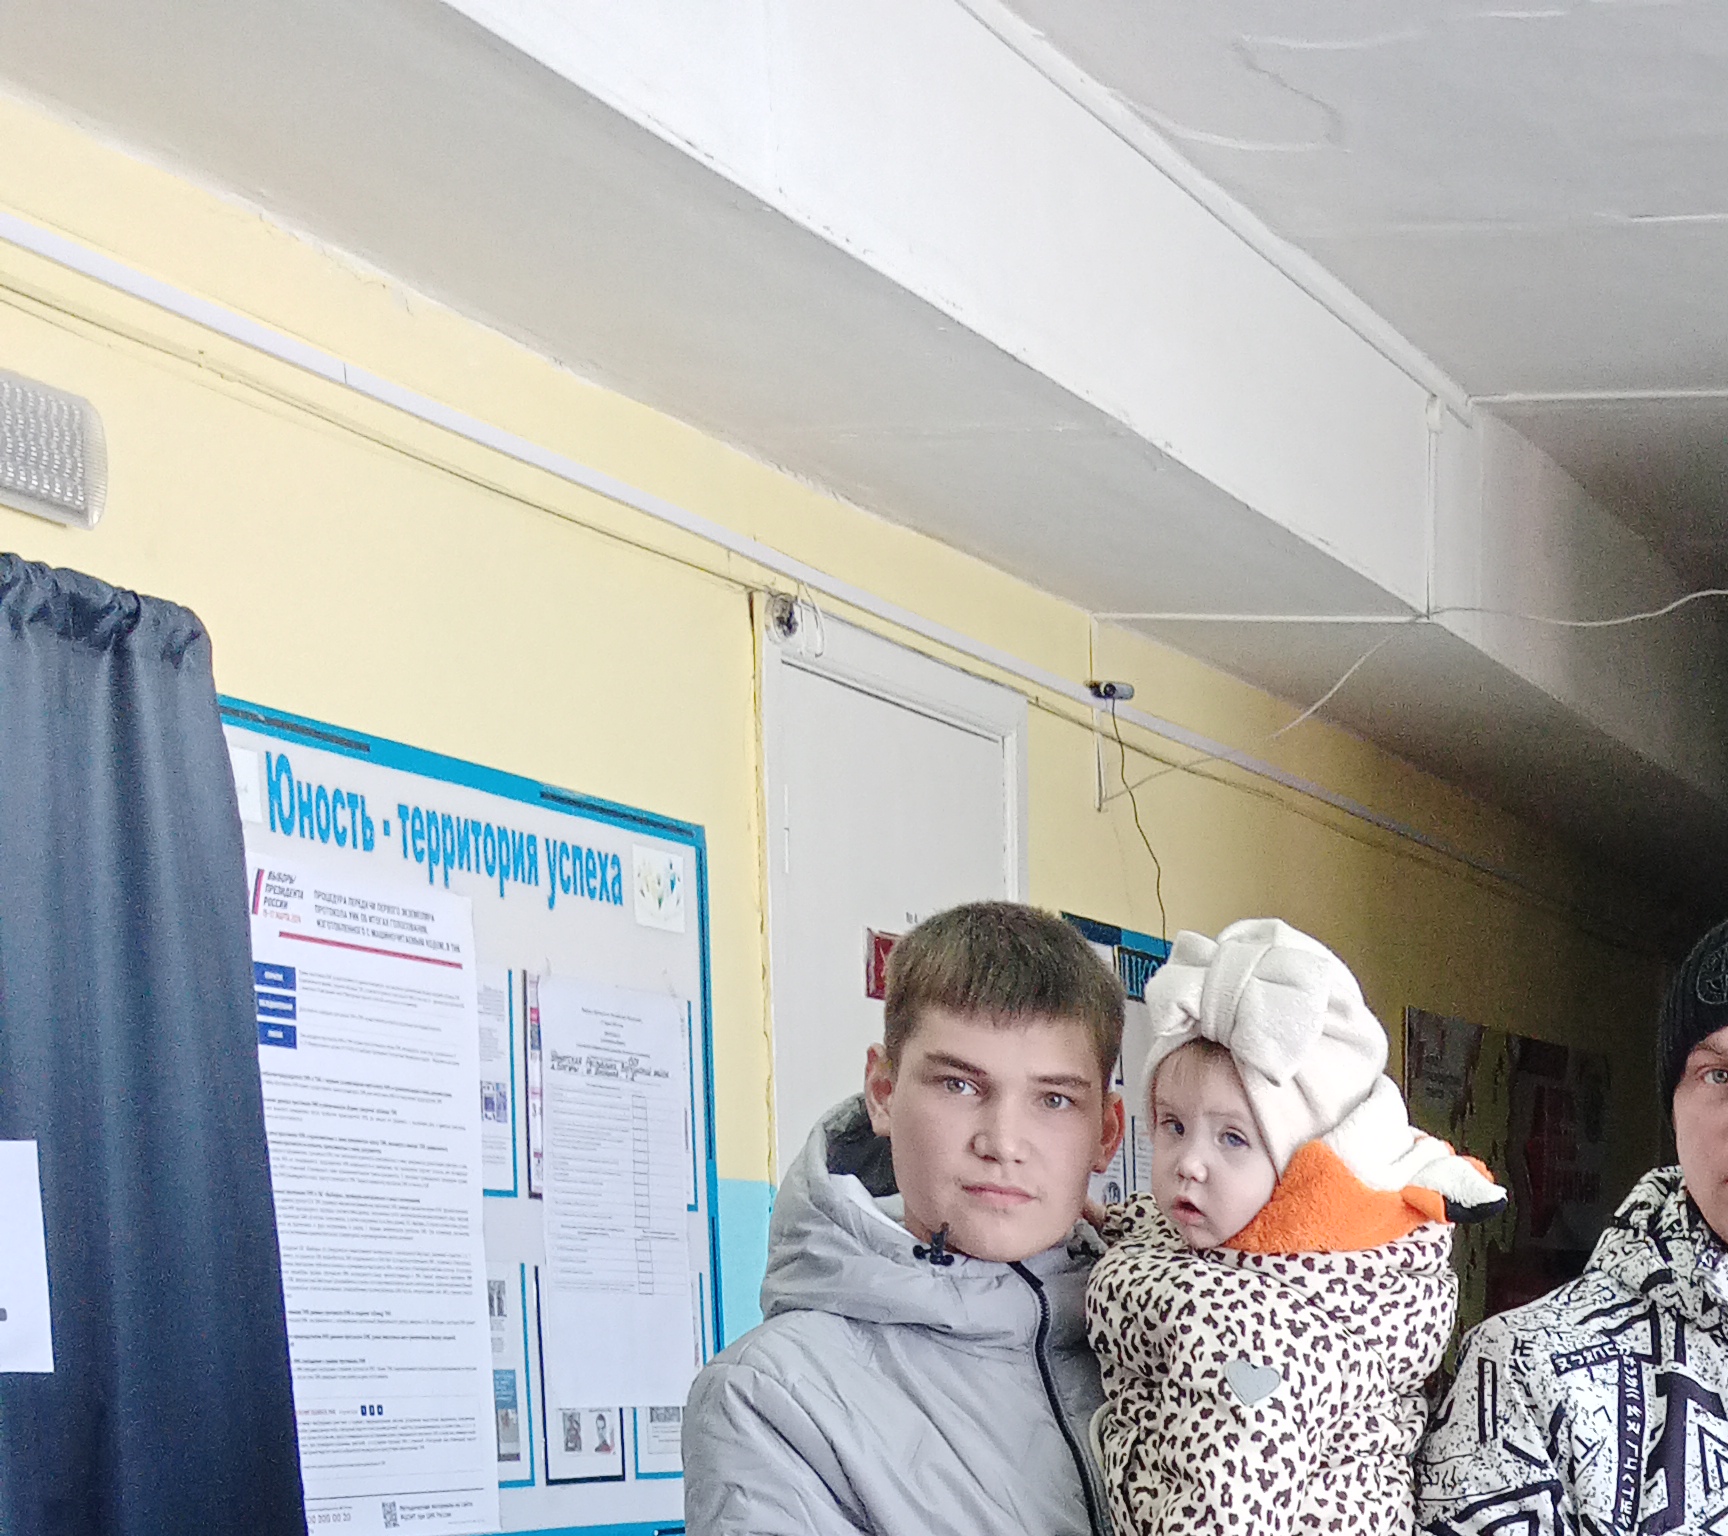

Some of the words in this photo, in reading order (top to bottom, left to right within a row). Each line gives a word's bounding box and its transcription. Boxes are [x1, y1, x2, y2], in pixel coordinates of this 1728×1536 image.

[265, 750, 375, 852] Юность
[397, 803, 539, 898] территория
[544, 837, 624, 910] успеха
